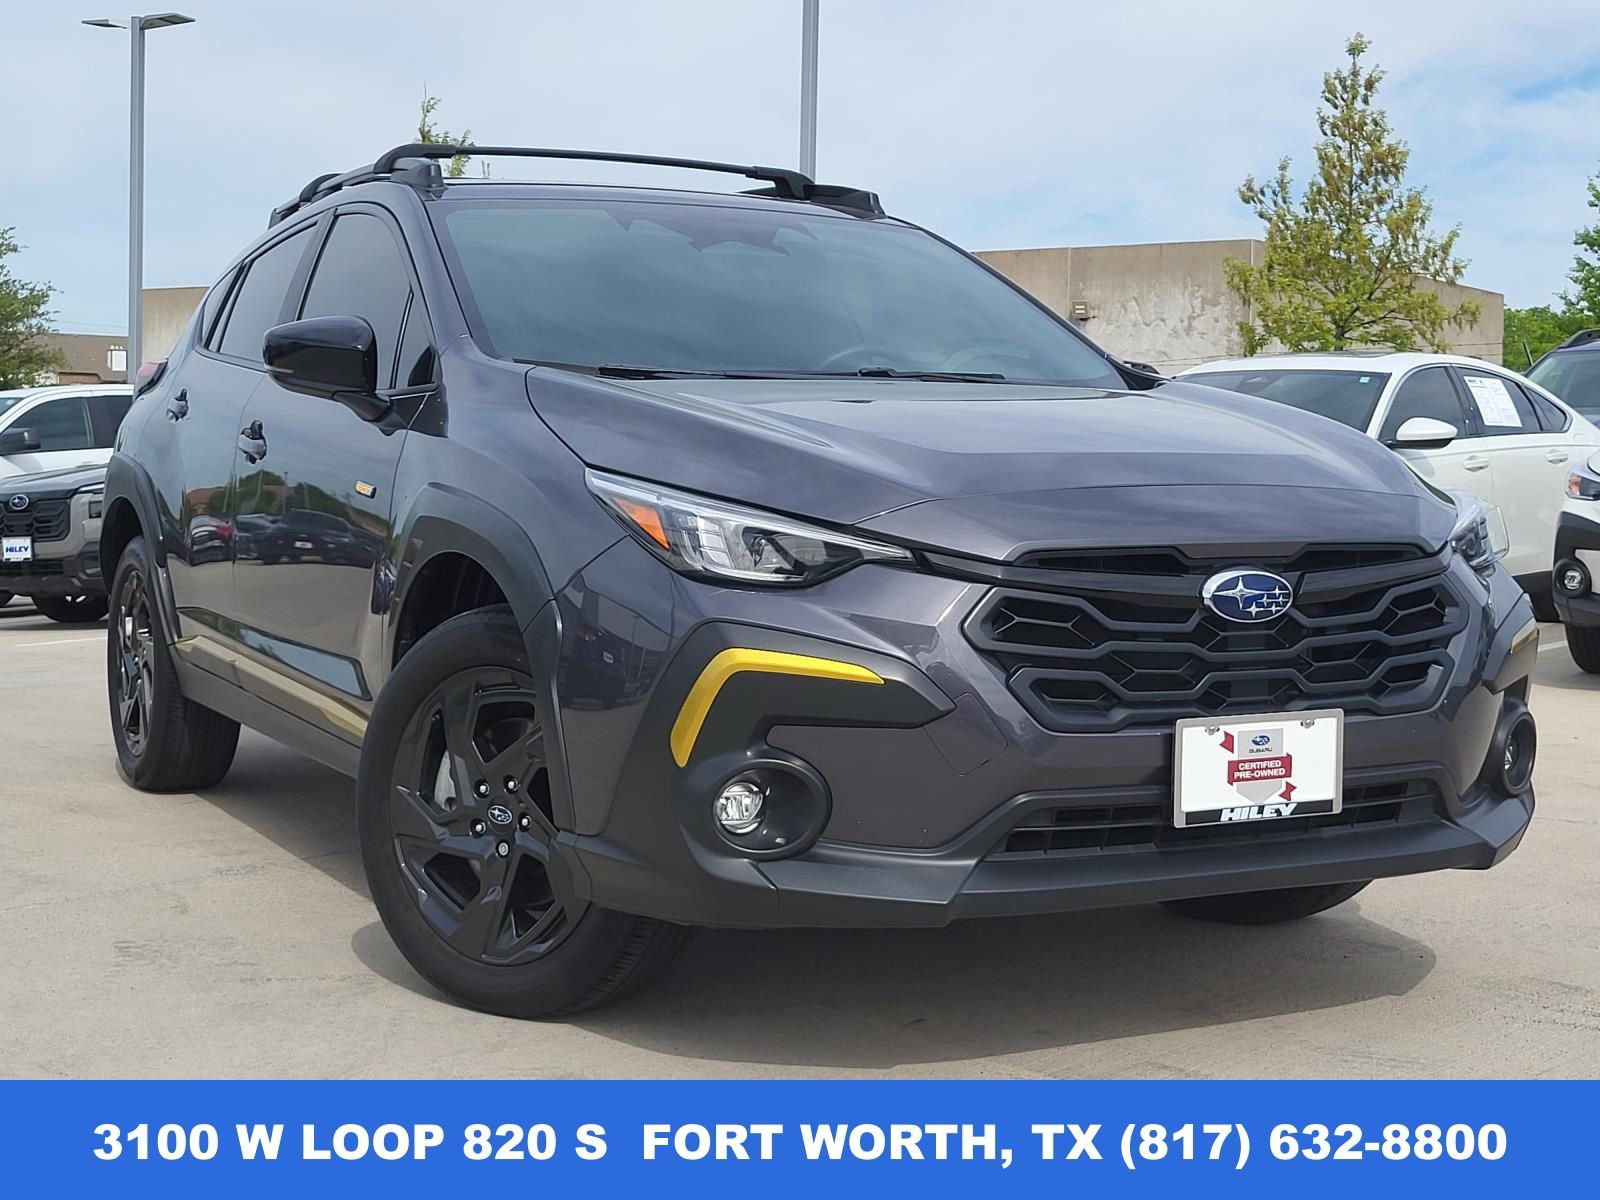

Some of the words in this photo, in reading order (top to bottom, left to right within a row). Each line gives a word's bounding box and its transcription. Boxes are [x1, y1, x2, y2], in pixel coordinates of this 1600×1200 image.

[1238, 760, 1282, 771] CERTIFIED
[1233, 767, 1286, 779] PRE-OWNED
[1220, 802, 1298, 822] HILEY
